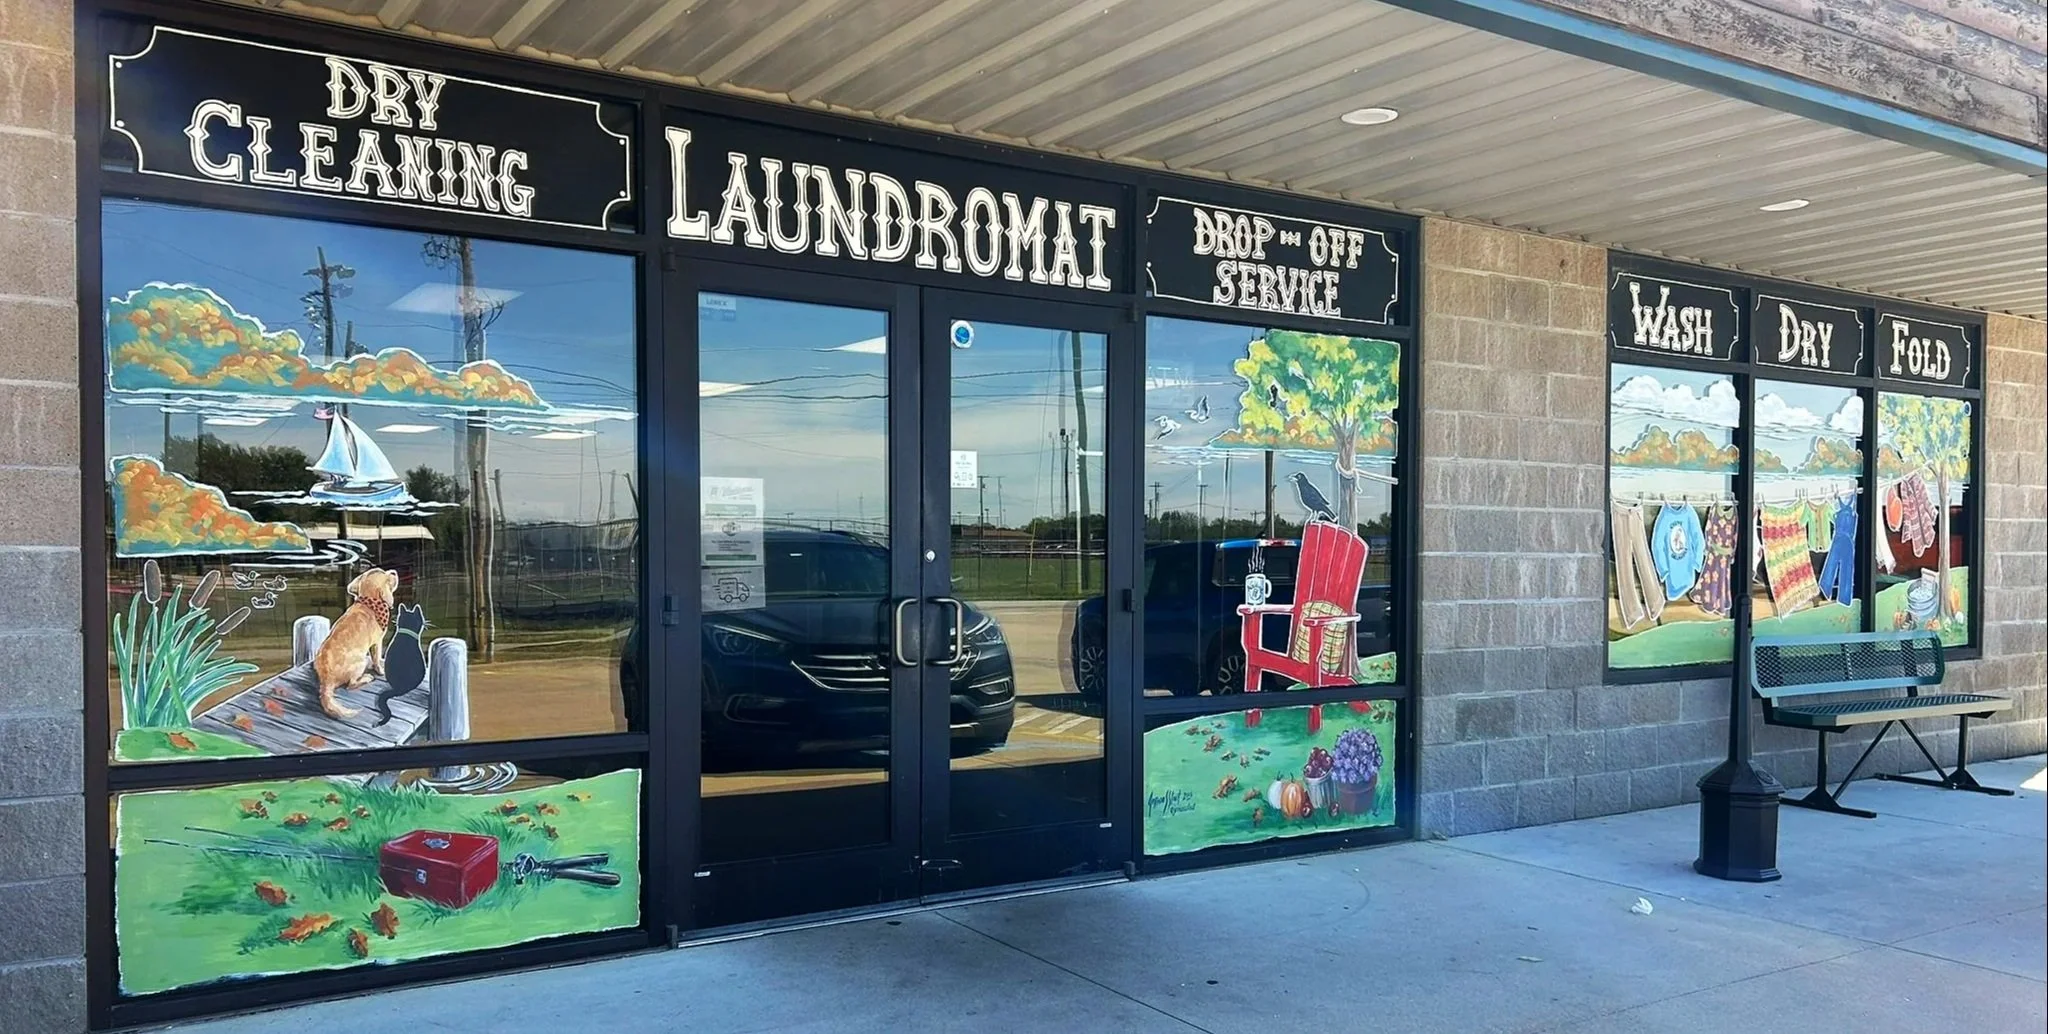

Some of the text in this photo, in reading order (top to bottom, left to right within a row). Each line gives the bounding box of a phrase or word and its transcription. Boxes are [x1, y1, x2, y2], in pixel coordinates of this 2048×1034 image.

[326, 56, 446, 131] DRY
[183, 98, 535, 218] CLEANING
[665, 125, 1117, 293] LAUNDROMAT
[1213, 260, 1341, 317] SERVICE
[1629, 281, 1713, 356] WASH
[1778, 303, 1834, 369] DRY
[1890, 320, 1952, 381] FOLD
